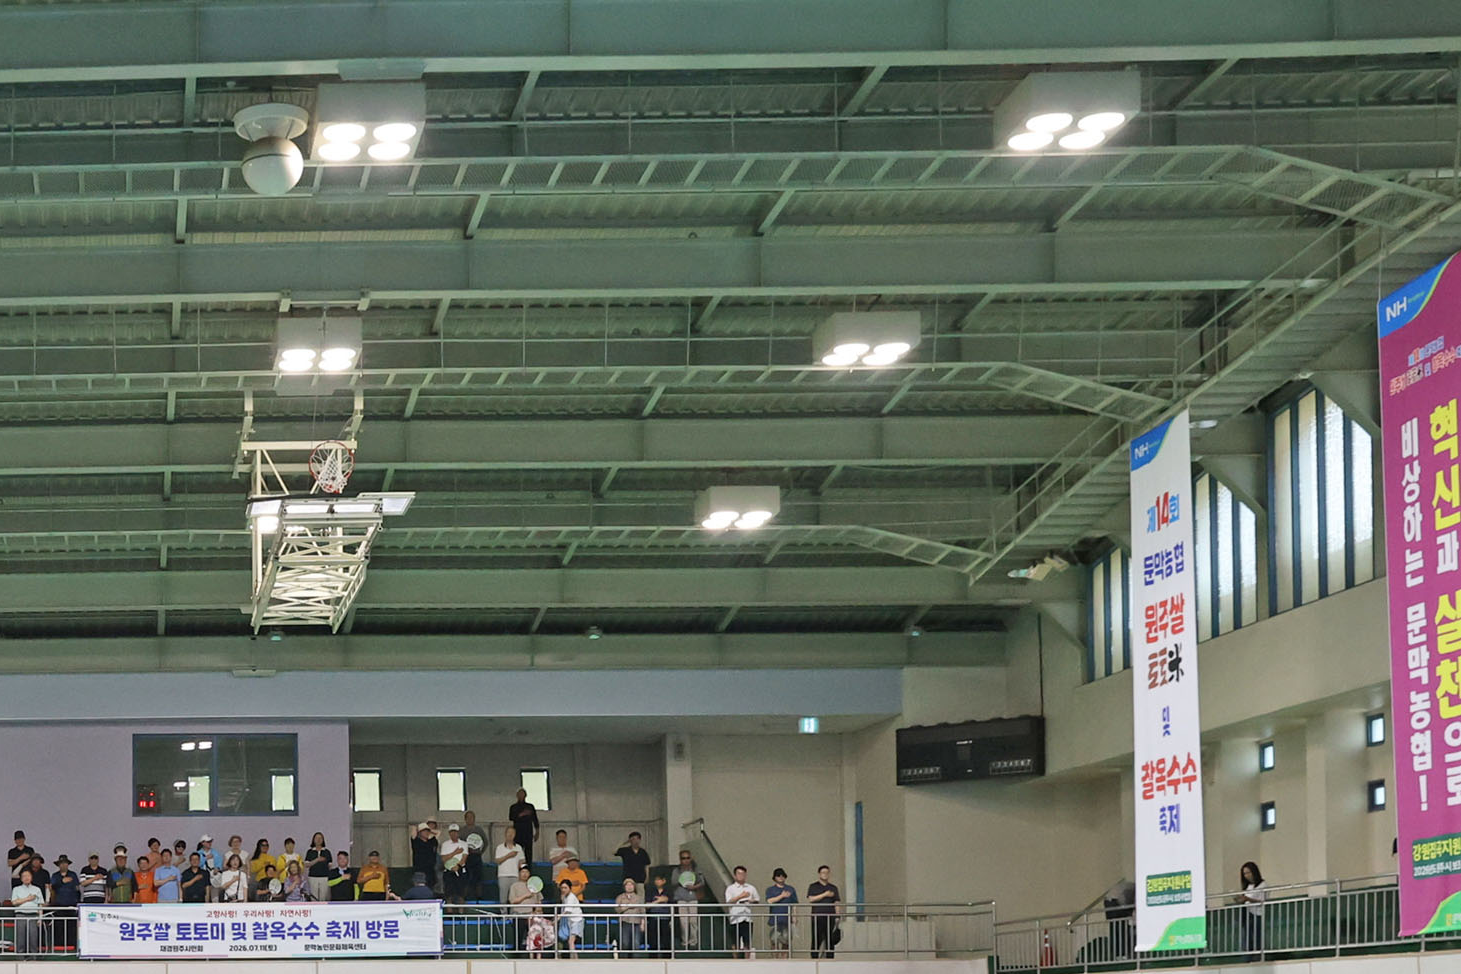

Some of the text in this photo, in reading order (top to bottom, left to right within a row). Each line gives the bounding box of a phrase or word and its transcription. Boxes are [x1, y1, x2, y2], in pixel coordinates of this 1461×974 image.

[1385, 296, 1408, 323] NH
[1401, 417, 1424, 588] 비상하는
[1429, 398, 1461, 575] 혁신과
[1147, 491, 1180, 534] 제14회
[1143, 541, 1185, 586] 문막농협
[1145, 592, 1185, 644] 원주쌀
[1162, 705, 1171, 737] 및
[1406, 602, 1433, 811] 문막농협!
[1141, 751, 1198, 800] 찰옥수수
[1159, 803, 1181, 835] 축제
[119, 920, 400, 941] 원주쌀 토토미 및 찰옥수수 축제 방문
[206, 909, 312, 918] 고향사랑! 우리사랑! 자연사랑!
